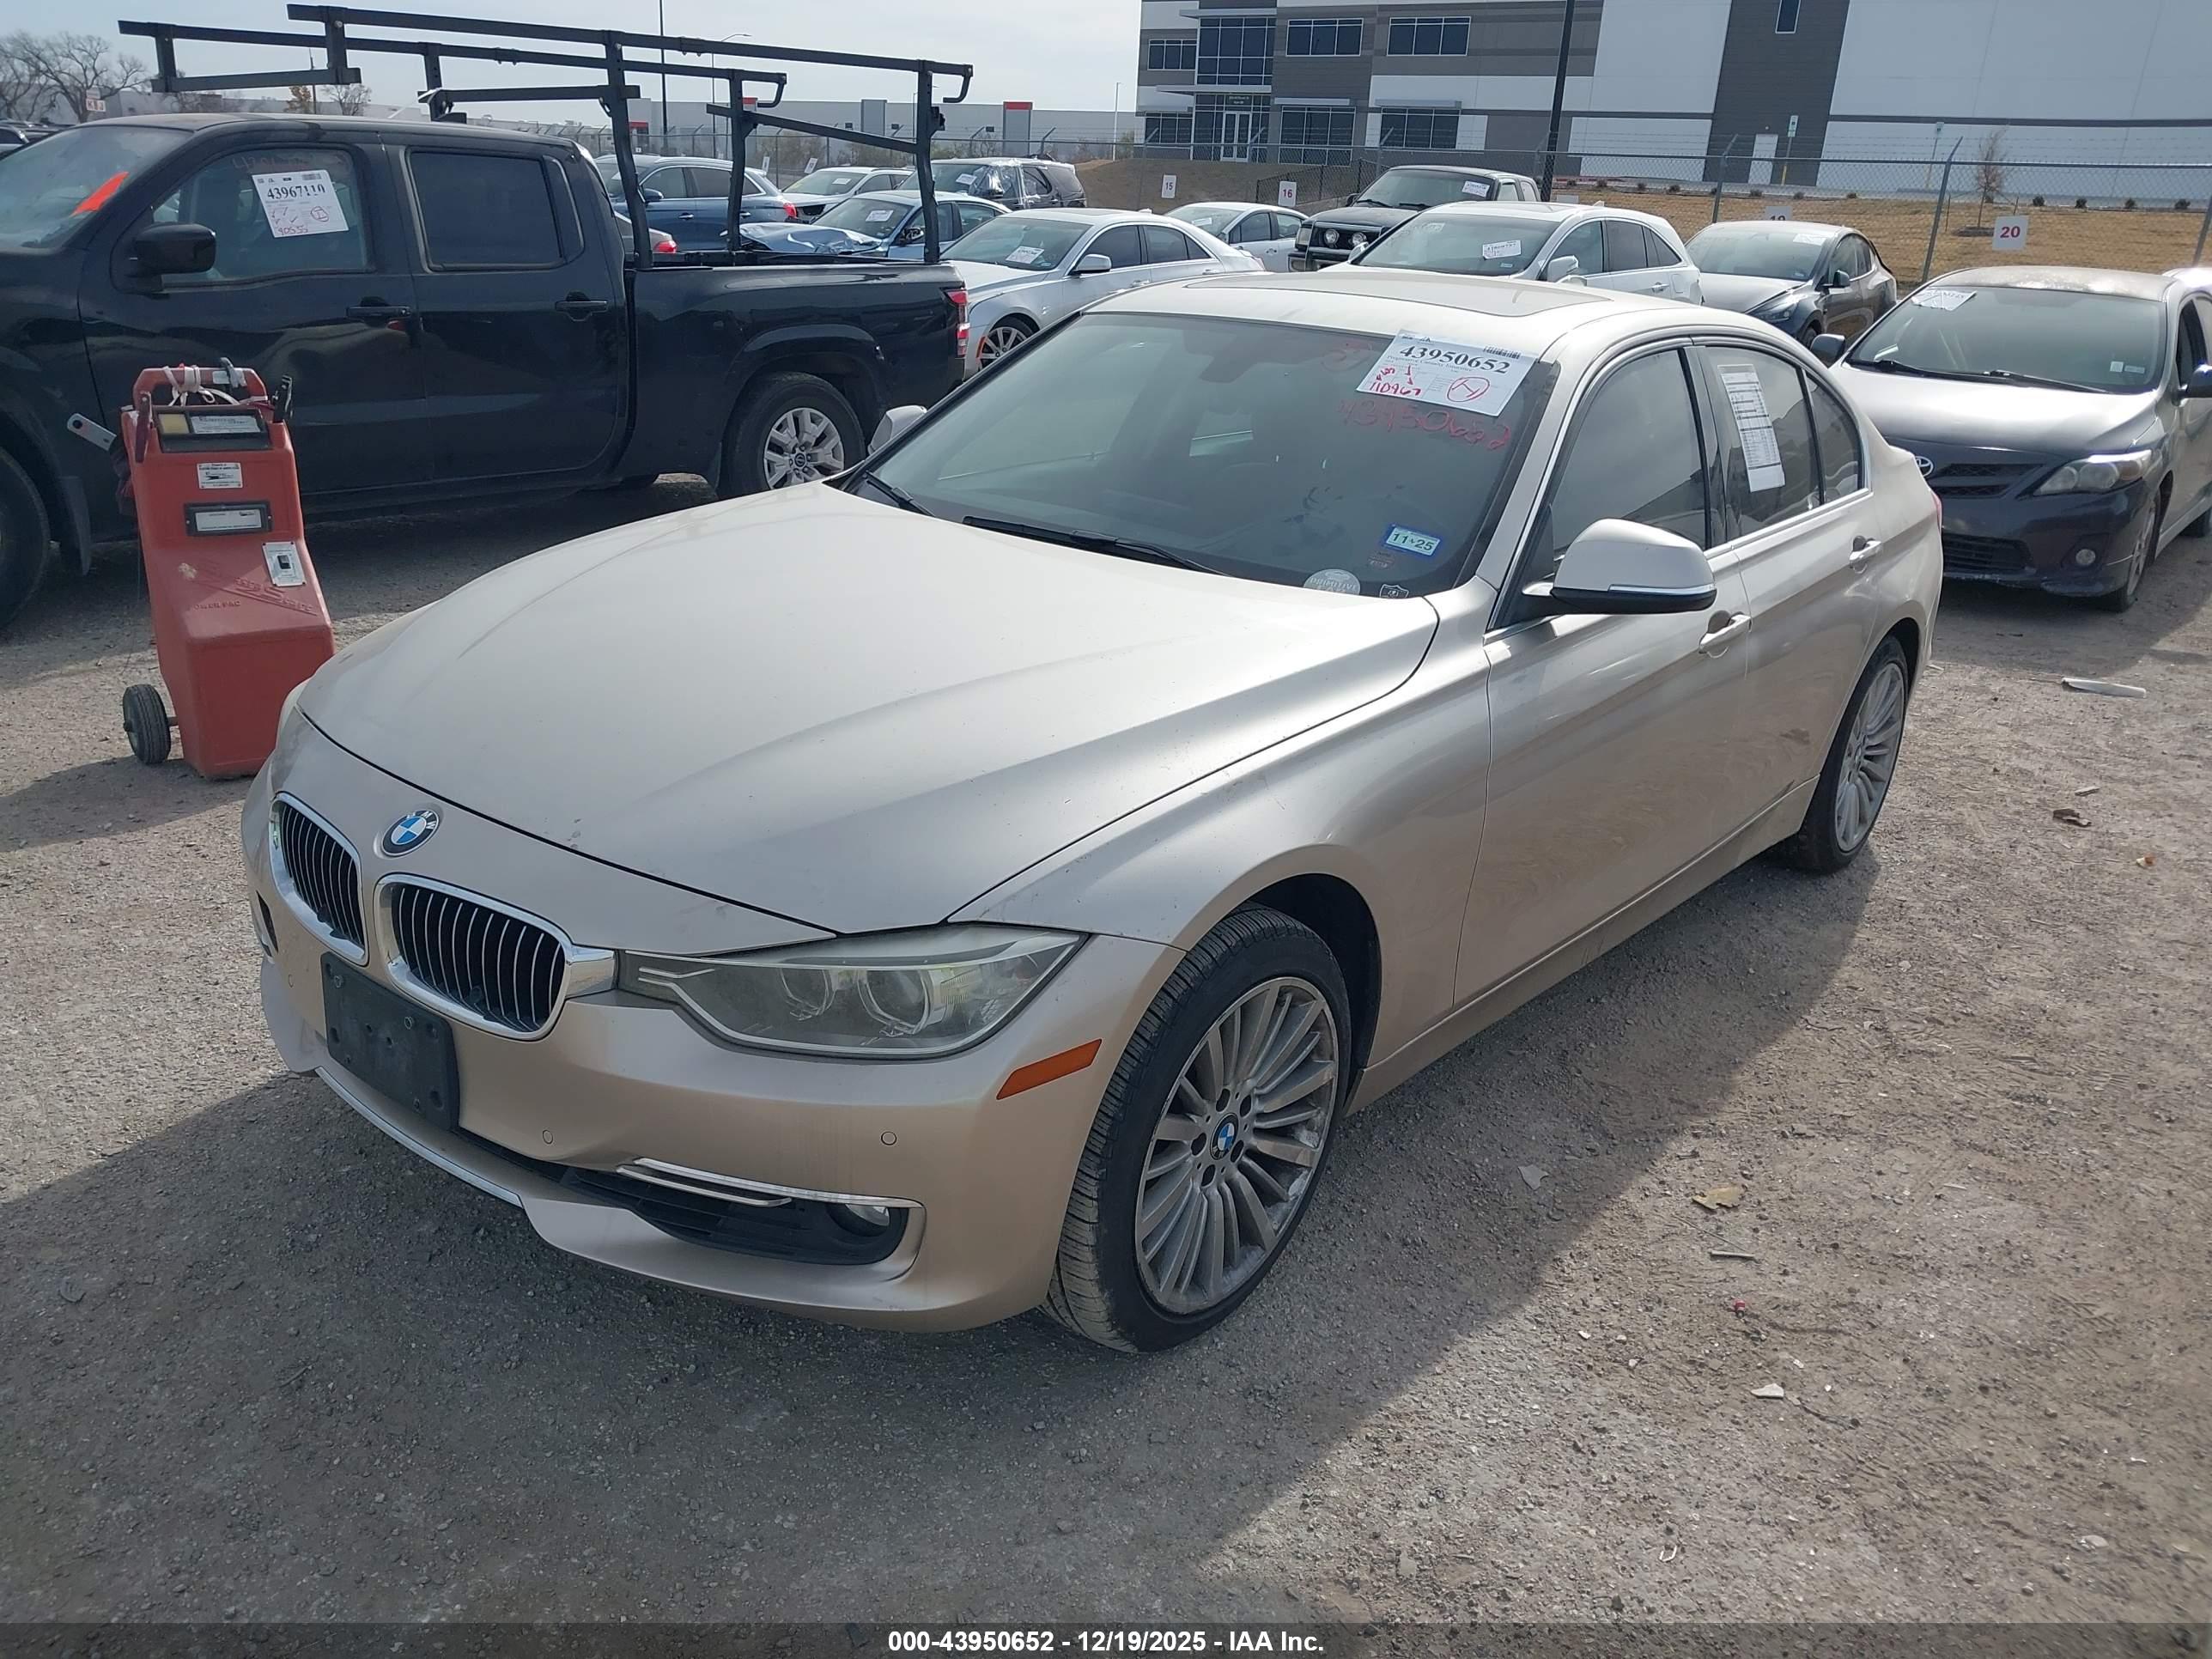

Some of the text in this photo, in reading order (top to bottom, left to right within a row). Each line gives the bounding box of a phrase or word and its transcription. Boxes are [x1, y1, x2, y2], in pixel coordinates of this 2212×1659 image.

[1165, 182, 1174, 191] 15
[1283, 189, 1292, 198] 16
[2000, 226, 2021, 239] 20
[1400, 345, 1511, 374] 43950652
[1393, 532, 1434, 550] 11 25
